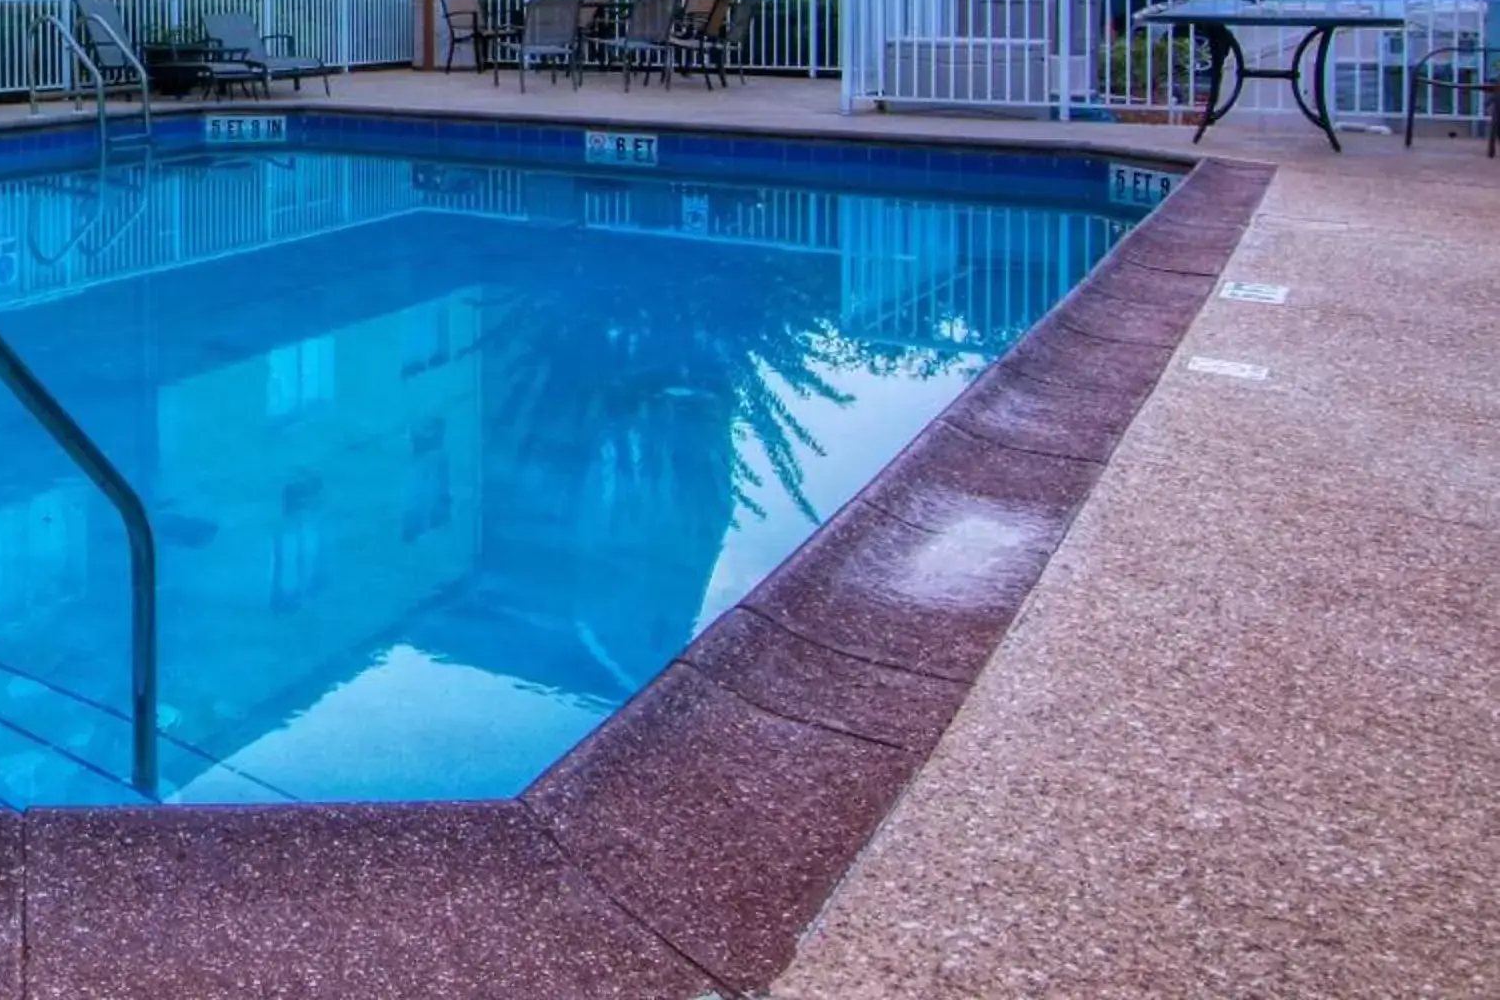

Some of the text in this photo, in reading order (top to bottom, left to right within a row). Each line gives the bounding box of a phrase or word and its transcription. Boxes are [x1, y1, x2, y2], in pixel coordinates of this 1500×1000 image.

[633, 138, 654, 158] FT
[1116, 170, 1125, 195] 5
[1134, 172, 1152, 198] FT
